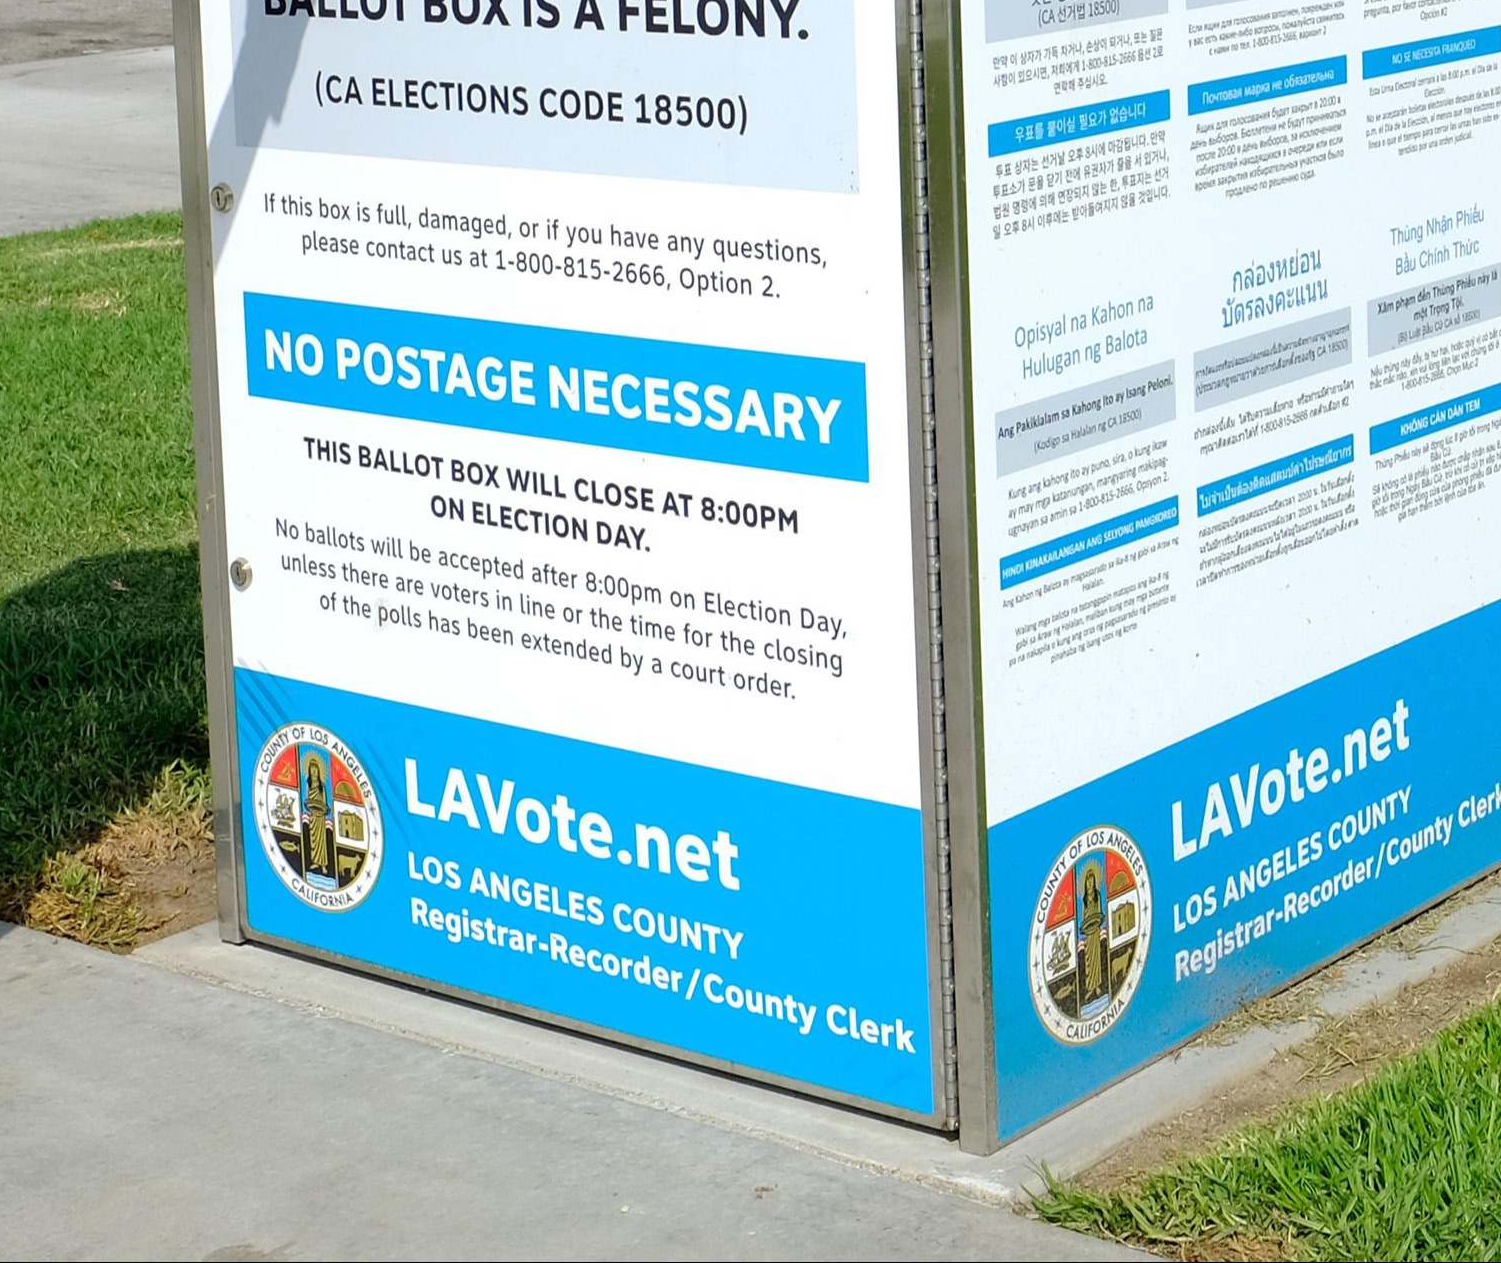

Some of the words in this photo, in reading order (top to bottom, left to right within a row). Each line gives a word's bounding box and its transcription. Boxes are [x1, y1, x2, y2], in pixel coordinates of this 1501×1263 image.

[315, 70, 363, 107] (CA
[371, 77, 529, 116] ELECTIONS
[539, 88, 624, 122] CODE
[634, 93, 747, 136] 18500)
[264, 192, 276, 213] If
[280, 194, 313, 217] this
[318, 197, 351, 221] box
[356, 201, 371, 223] is
[376, 202, 412, 230] full,
[418, 207, 512, 240] damaged,
[519, 221, 539, 239] or
[546, 218, 559, 241] if
[566, 226, 602, 248] you
[610, 224, 659, 250] have
[667, 235, 705, 261] any
[713, 238, 827, 269] questions,
[1389, 224, 1424, 246] Thùng
[1426, 214, 1454, 237] Nhận
[1455, 202, 1485, 229] Phiếu
[1395, 251, 1417, 276] Bầu
[1419, 245, 1450, 269] Chính
[1452, 238, 1480, 259] Thức
[302, 230, 359, 256] please
[366, 241, 435, 263] contact
[442, 248, 463, 266] us
[469, 248, 488, 269] at
[495, 249, 671, 291] 1-800-815-2666,
[679, 267, 753, 298] Option
[762, 275, 781, 299] 2.
[1014, 313, 1066, 350] Opisyal
[1070, 314, 1087, 333] na
[1091, 300, 1134, 327] Kahon
[1137, 295, 1154, 314] na
[1022, 348, 1081, 380] Hulugan
[1084, 342, 1102, 364] ng
[1105, 329, 1148, 355] Balota
[264, 329, 324, 376] NO
[336, 338, 536, 406] POSTAGE
[548, 365, 842, 444] NECESSARY
[997, 426, 1015, 440] Ang
[1061, 408, 1071, 420] sa
[1071, 398, 1102, 416] Kahong
[1102, 394, 1114, 407] Ito
[1115, 392, 1125, 404] ay
[1125, 384, 1147, 400] Isang
[303, 436, 351, 465] THIS
[358, 444, 444, 479] BALLOT
[451, 459, 501, 489] BOX
[506, 467, 567, 499] WILL
[574, 478, 655, 513] CLOSE
[661, 491, 693, 518] AT
[701, 496, 799, 534] 8:00PM
[430, 495, 464, 522] ON
[472, 501, 588, 542] ELECTION
[596, 521, 650, 553] DAY.
[275, 517, 299, 540] No
[305, 522, 365, 552] ballots
[370, 536, 404, 559] will
[409, 540, 431, 564] be
[438, 550, 524, 580] accepted
[531, 563, 578, 589] after
[585, 571, 662, 606] 8:00pm
[670, 590, 695, 611] on
[704, 591, 791, 626] Election
[800, 607, 847, 641] Day,
[281, 553, 337, 580] unless
[341, 562, 389, 589] there
[395, 576, 424, 596] are
[430, 582, 489, 608] voters
[496, 589, 513, 612] in
[519, 593, 556, 620] line
[562, 606, 583, 624] or
[589, 607, 623, 632] the
[629, 614, 676, 642] time
[683, 622, 713, 648] for
[720, 630, 755, 656] the
[763, 638, 843, 678] closing
[319, 591, 337, 612] of
[342, 595, 372, 619] the
[378, 604, 422, 629] polls
[428, 609, 461, 636] has
[467, 617, 514, 646] been
[521, 633, 612, 665] extended
[620, 645, 644, 677] by
[651, 657, 663, 675] a
[670, 661, 726, 687] court
[733, 672, 796, 700] order.
[260, 730, 289, 773] COUNTY
[292, 727, 306, 740] OF
[309, 728, 329, 745] LOS
[331, 742, 373, 798] ANGELES
[1171, 699, 1410, 862] LAVote.net
[405, 757, 740, 891] LAVote.net
[1173, 885, 1217, 933] LOS
[1223, 831, 1323, 908] ANGELES
[1328, 785, 1411, 851] COUNTY
[291, 878, 354, 907] CALIFORNIA
[408, 851, 462, 890] LOS
[469, 867, 605, 926] ANGELES
[612, 903, 744, 960] COUNTY
[1037, 861, 1067, 924] COUNTY
[1069, 839, 1083, 860] OF
[1086, 831, 1105, 849] LOS
[1107, 831, 1144, 877] ANGELES
[826, 1004, 916, 1054] Clerk
[1065, 998, 1125, 1039] CALIFORNIA
